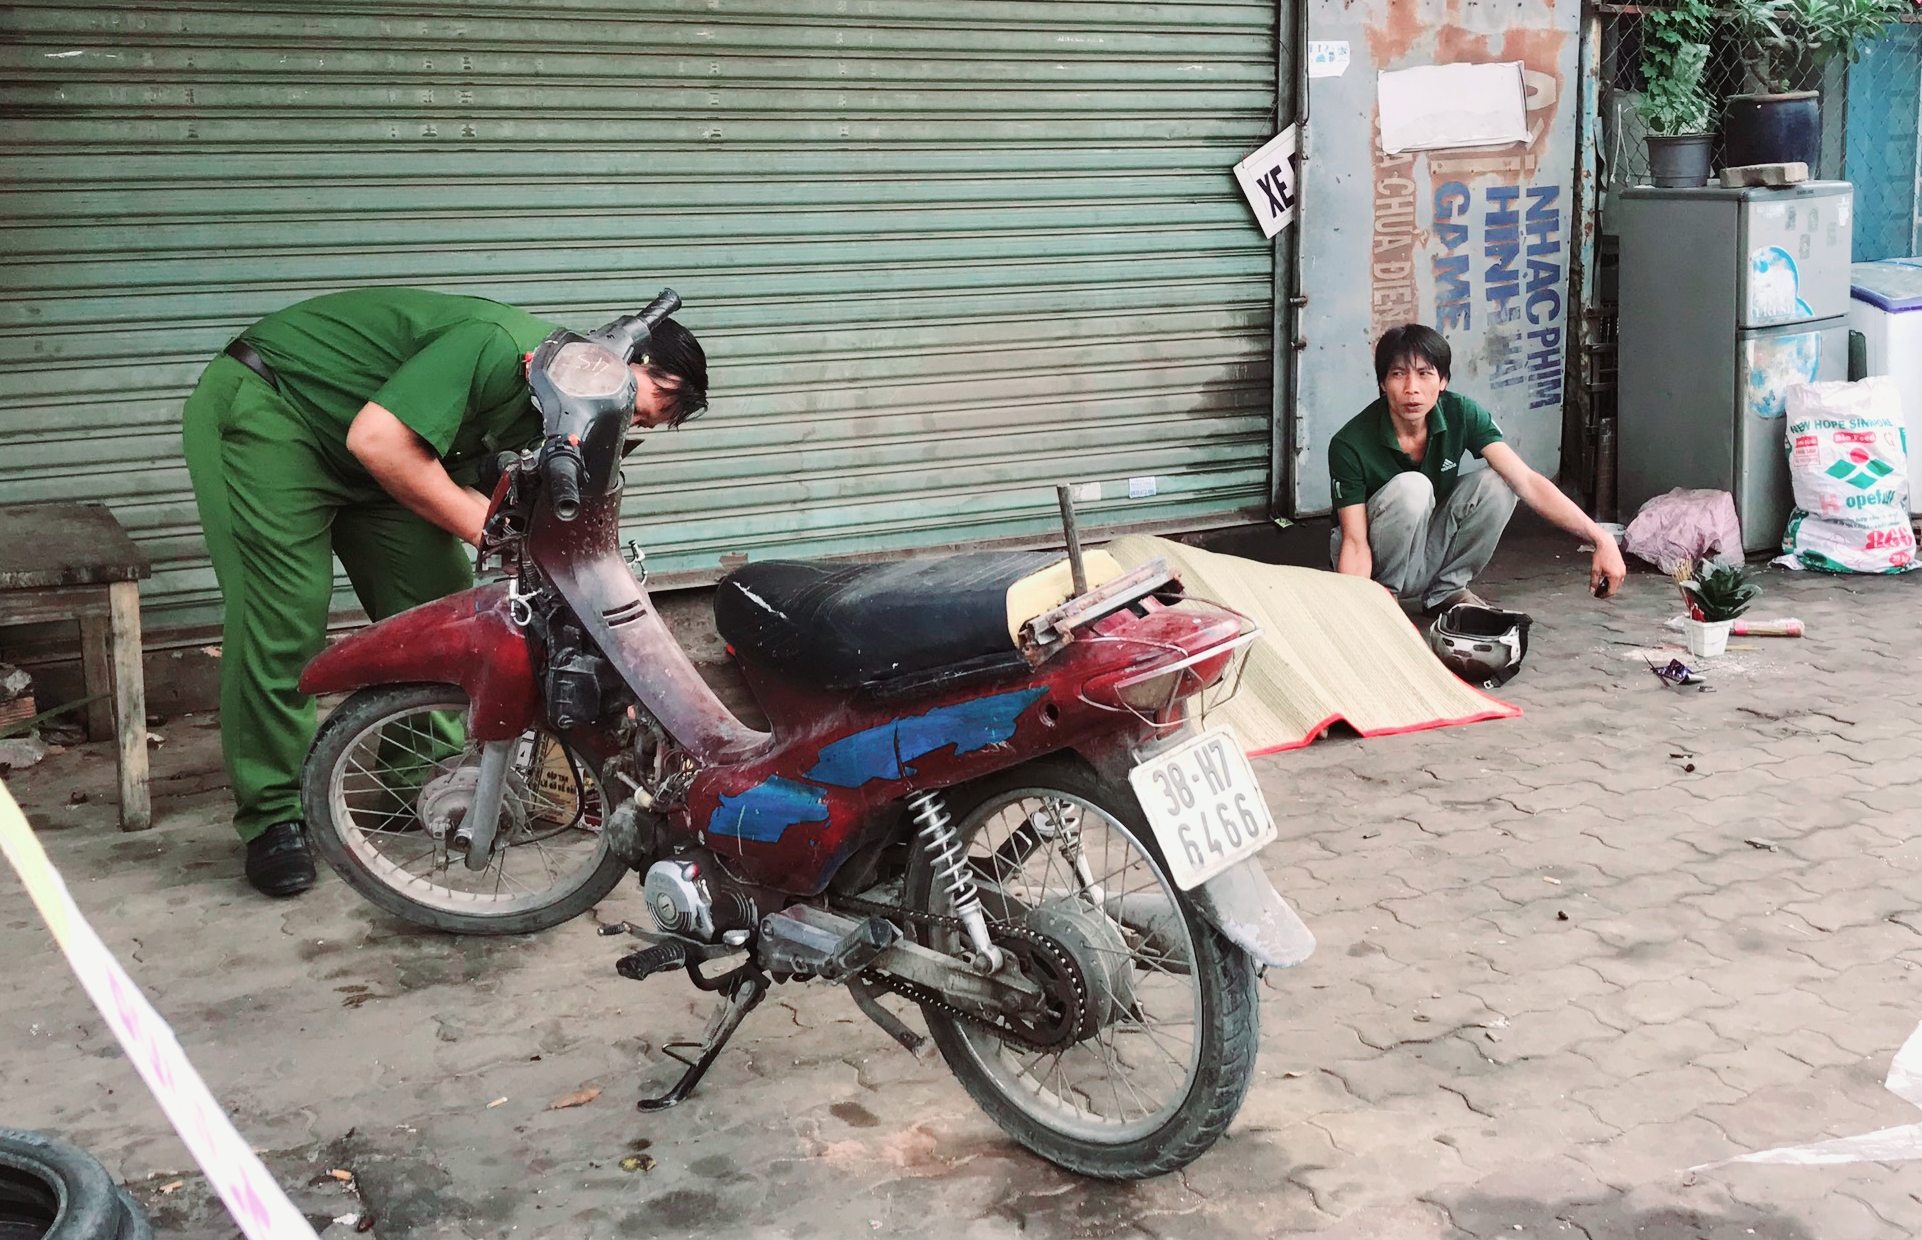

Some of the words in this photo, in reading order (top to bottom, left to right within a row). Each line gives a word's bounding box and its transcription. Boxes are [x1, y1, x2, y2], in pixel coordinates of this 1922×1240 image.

[1256, 164, 1296, 219] XE
[1433, 181, 1471, 332] GAME
[1523, 185, 1561, 325] NHẠC
[1528, 327, 1562, 410] PHIM
[1790, 421, 1810, 433] NEW
[1814, 420, 1846, 430] HOPE
[1177, 793, 1260, 870] 6466
